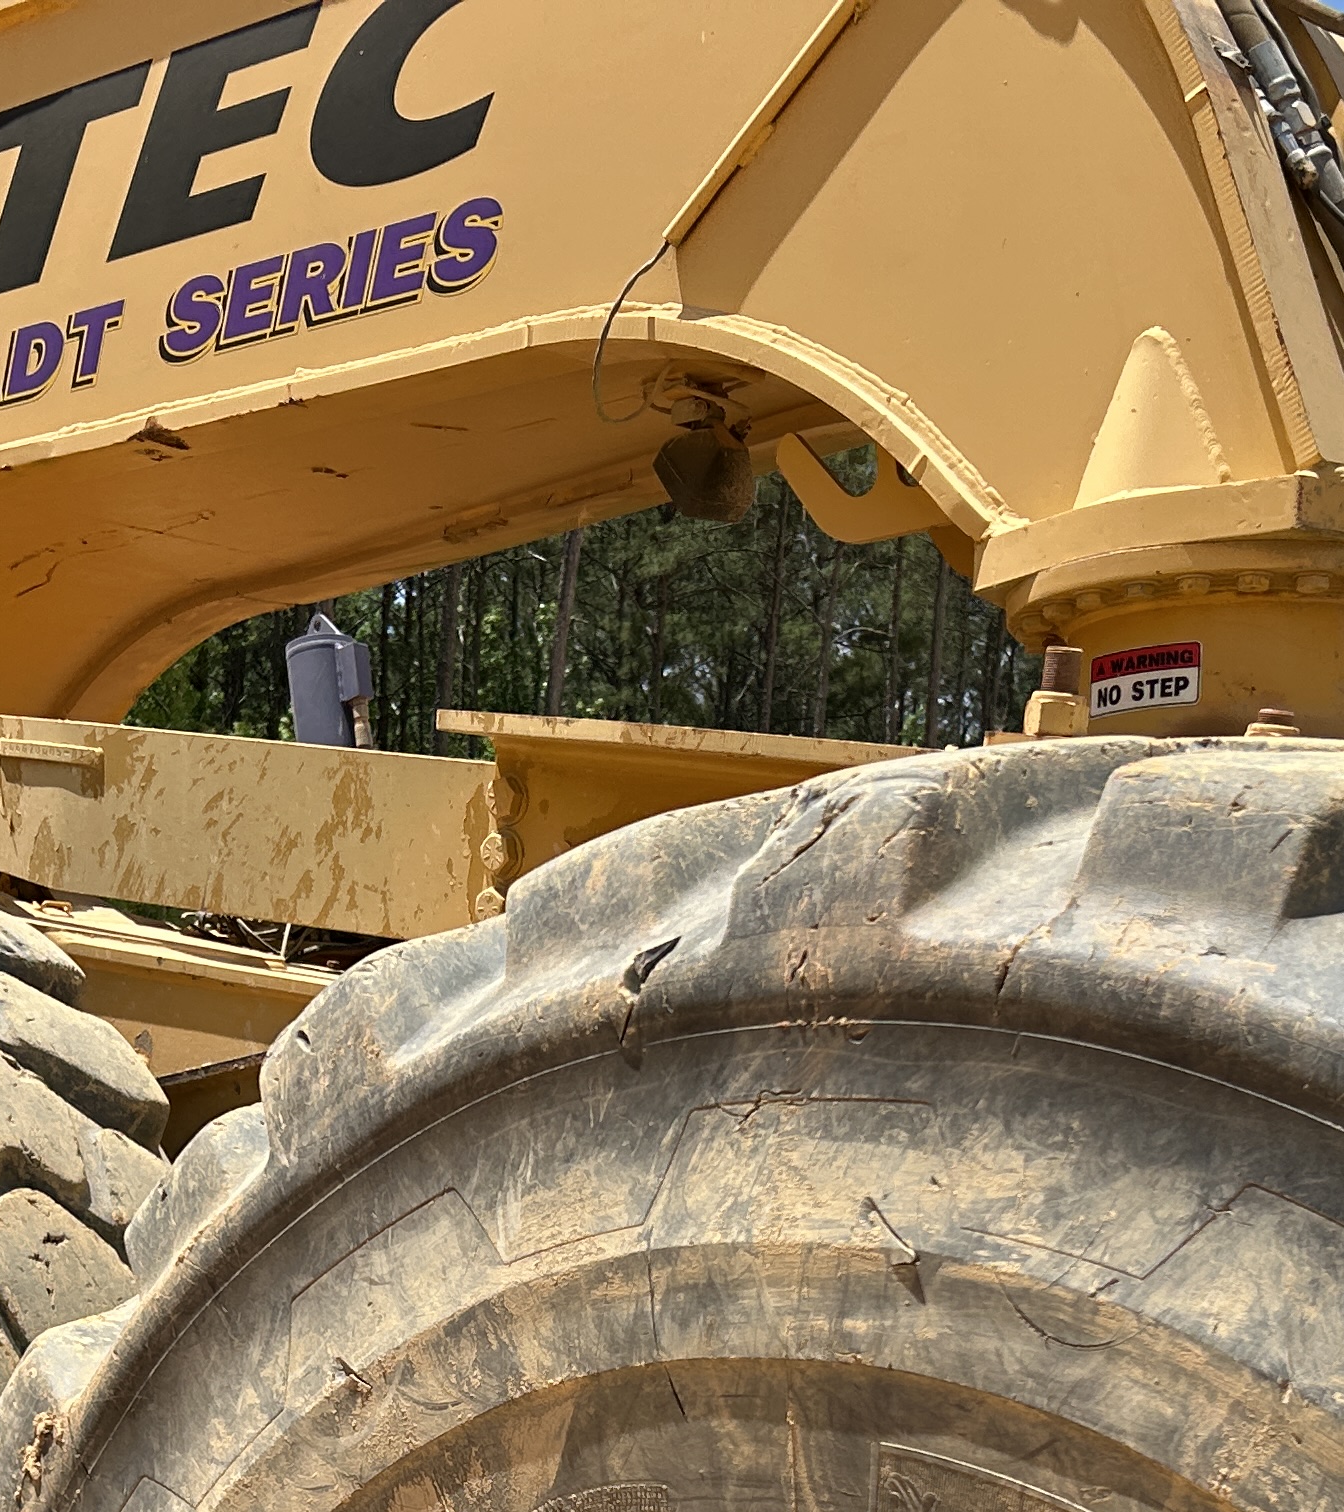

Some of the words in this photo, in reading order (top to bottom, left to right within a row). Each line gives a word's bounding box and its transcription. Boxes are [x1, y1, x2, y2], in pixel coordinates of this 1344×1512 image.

[158, 197, 503, 365] SERIES
[1110, 649, 1194, 675] WARNING
[1097, 684, 1121, 708] NO
[1131, 676, 1189, 701] STEP
